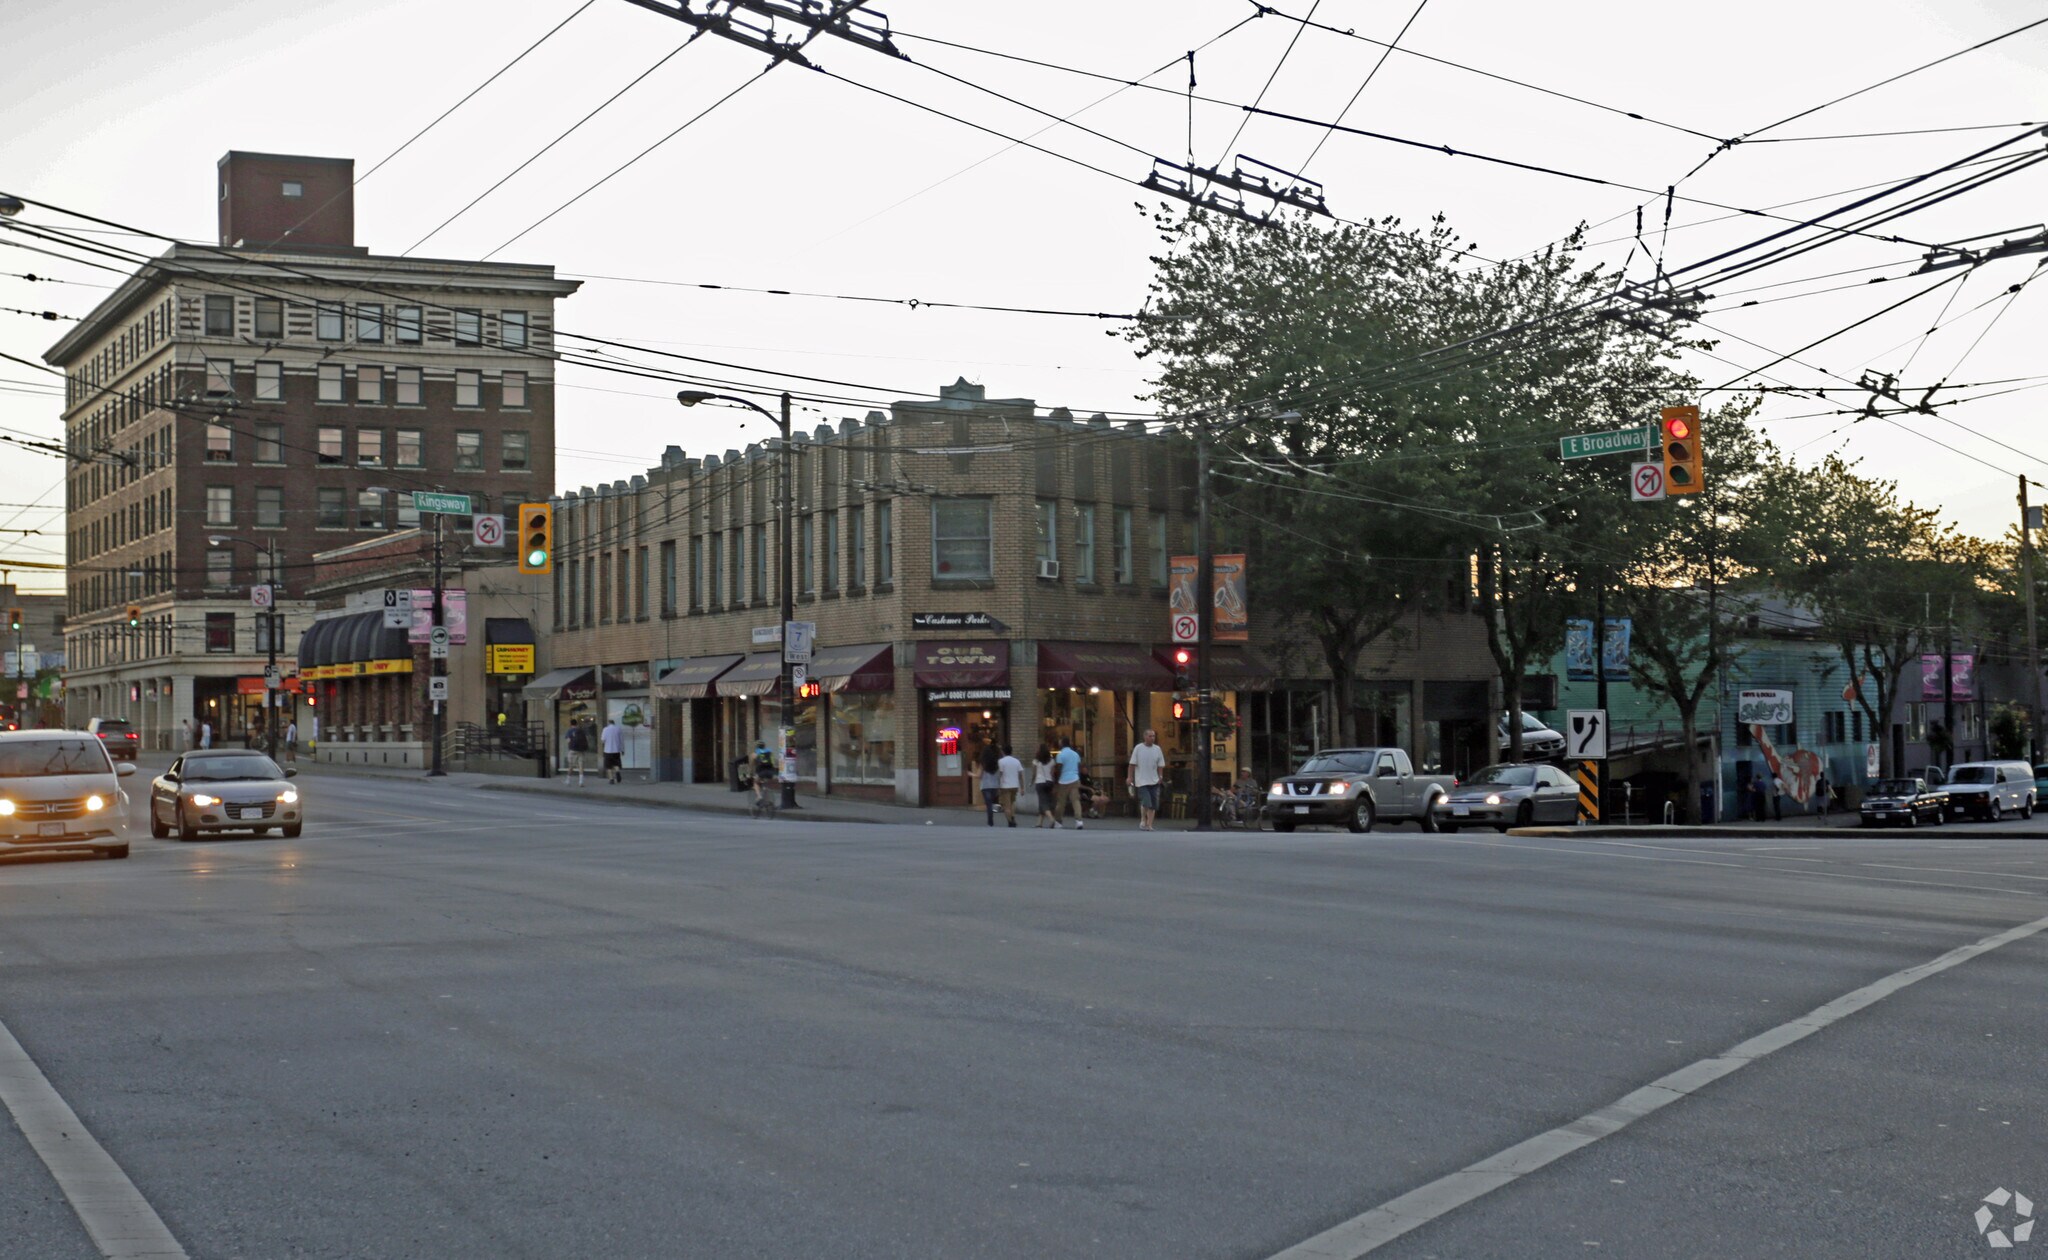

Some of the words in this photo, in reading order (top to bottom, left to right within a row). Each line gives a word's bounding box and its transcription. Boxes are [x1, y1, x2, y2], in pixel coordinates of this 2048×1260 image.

[1571, 439, 1578, 453] E
[1582, 432, 1647, 452] Broadway
[418, 494, 466, 512] Kingsway
[795, 632, 802, 641] 7
[937, 647, 984, 655] OUR
[926, 655, 996, 665] TOWN
[967, 690, 993, 699] CINNAMON
[995, 690, 1011, 698] ROLLS
[939, 730, 959, 739] OPEN
